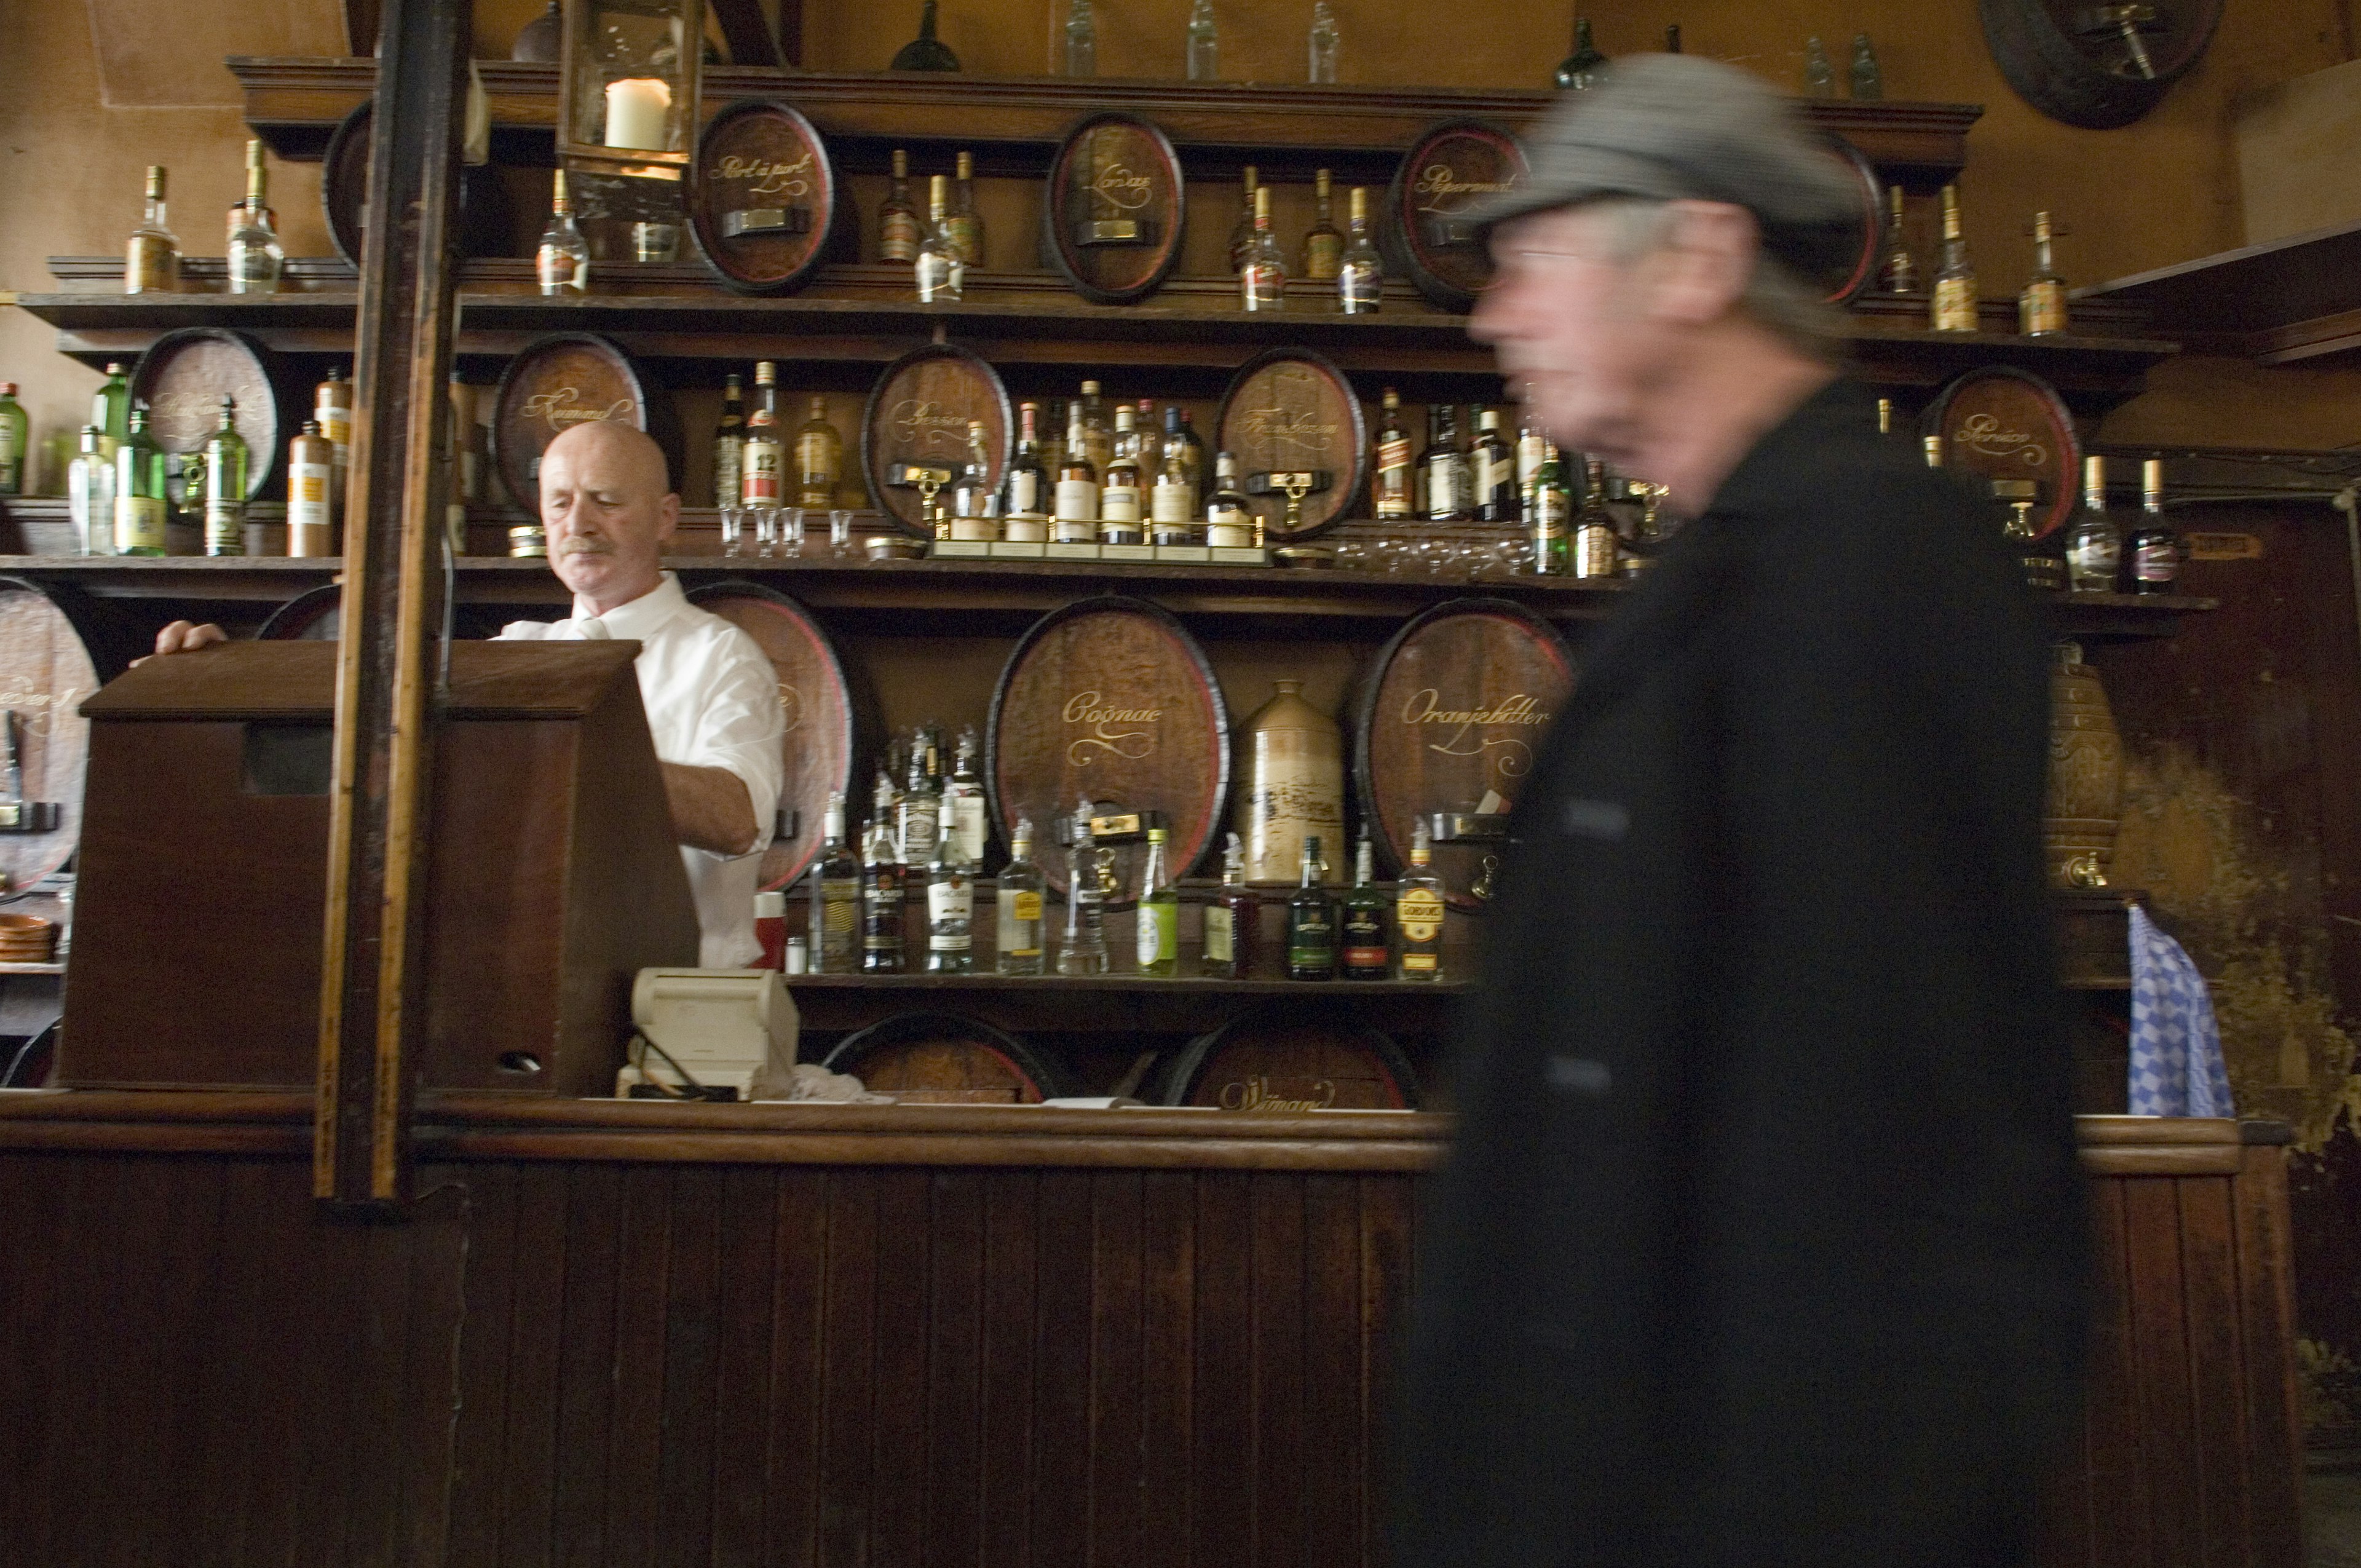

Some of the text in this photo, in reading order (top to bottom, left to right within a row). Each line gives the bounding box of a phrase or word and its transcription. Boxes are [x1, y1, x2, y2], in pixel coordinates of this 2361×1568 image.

[757, 454, 777, 471] 12
[1062, 691, 1163, 740] Cognac
[1401, 688, 1551, 751] Oranjebitter
